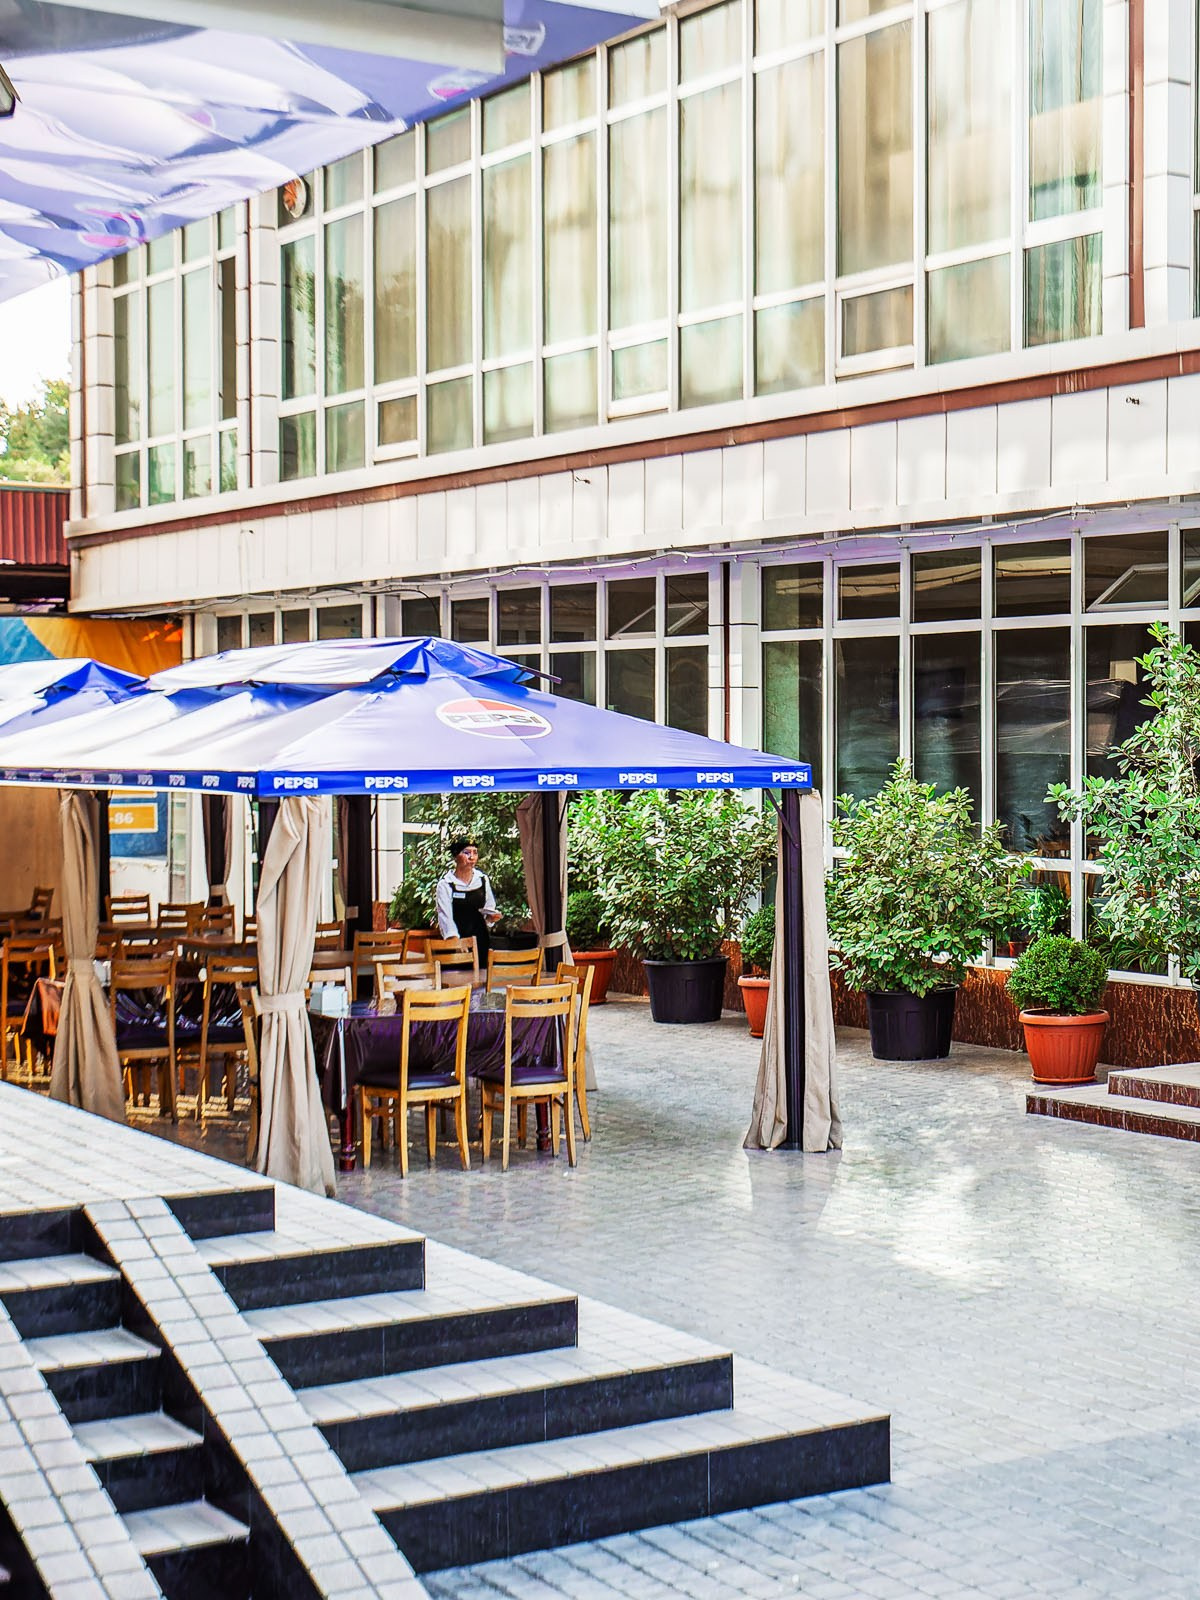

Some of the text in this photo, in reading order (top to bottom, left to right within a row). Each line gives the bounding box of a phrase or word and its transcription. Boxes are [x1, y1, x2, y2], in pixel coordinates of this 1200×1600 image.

[446, 713, 542, 723] PEPSI
[273, 771, 808, 790] PEPSI PEPSI PEPSI PEPSI PEPSI PEPSI PEPSI
